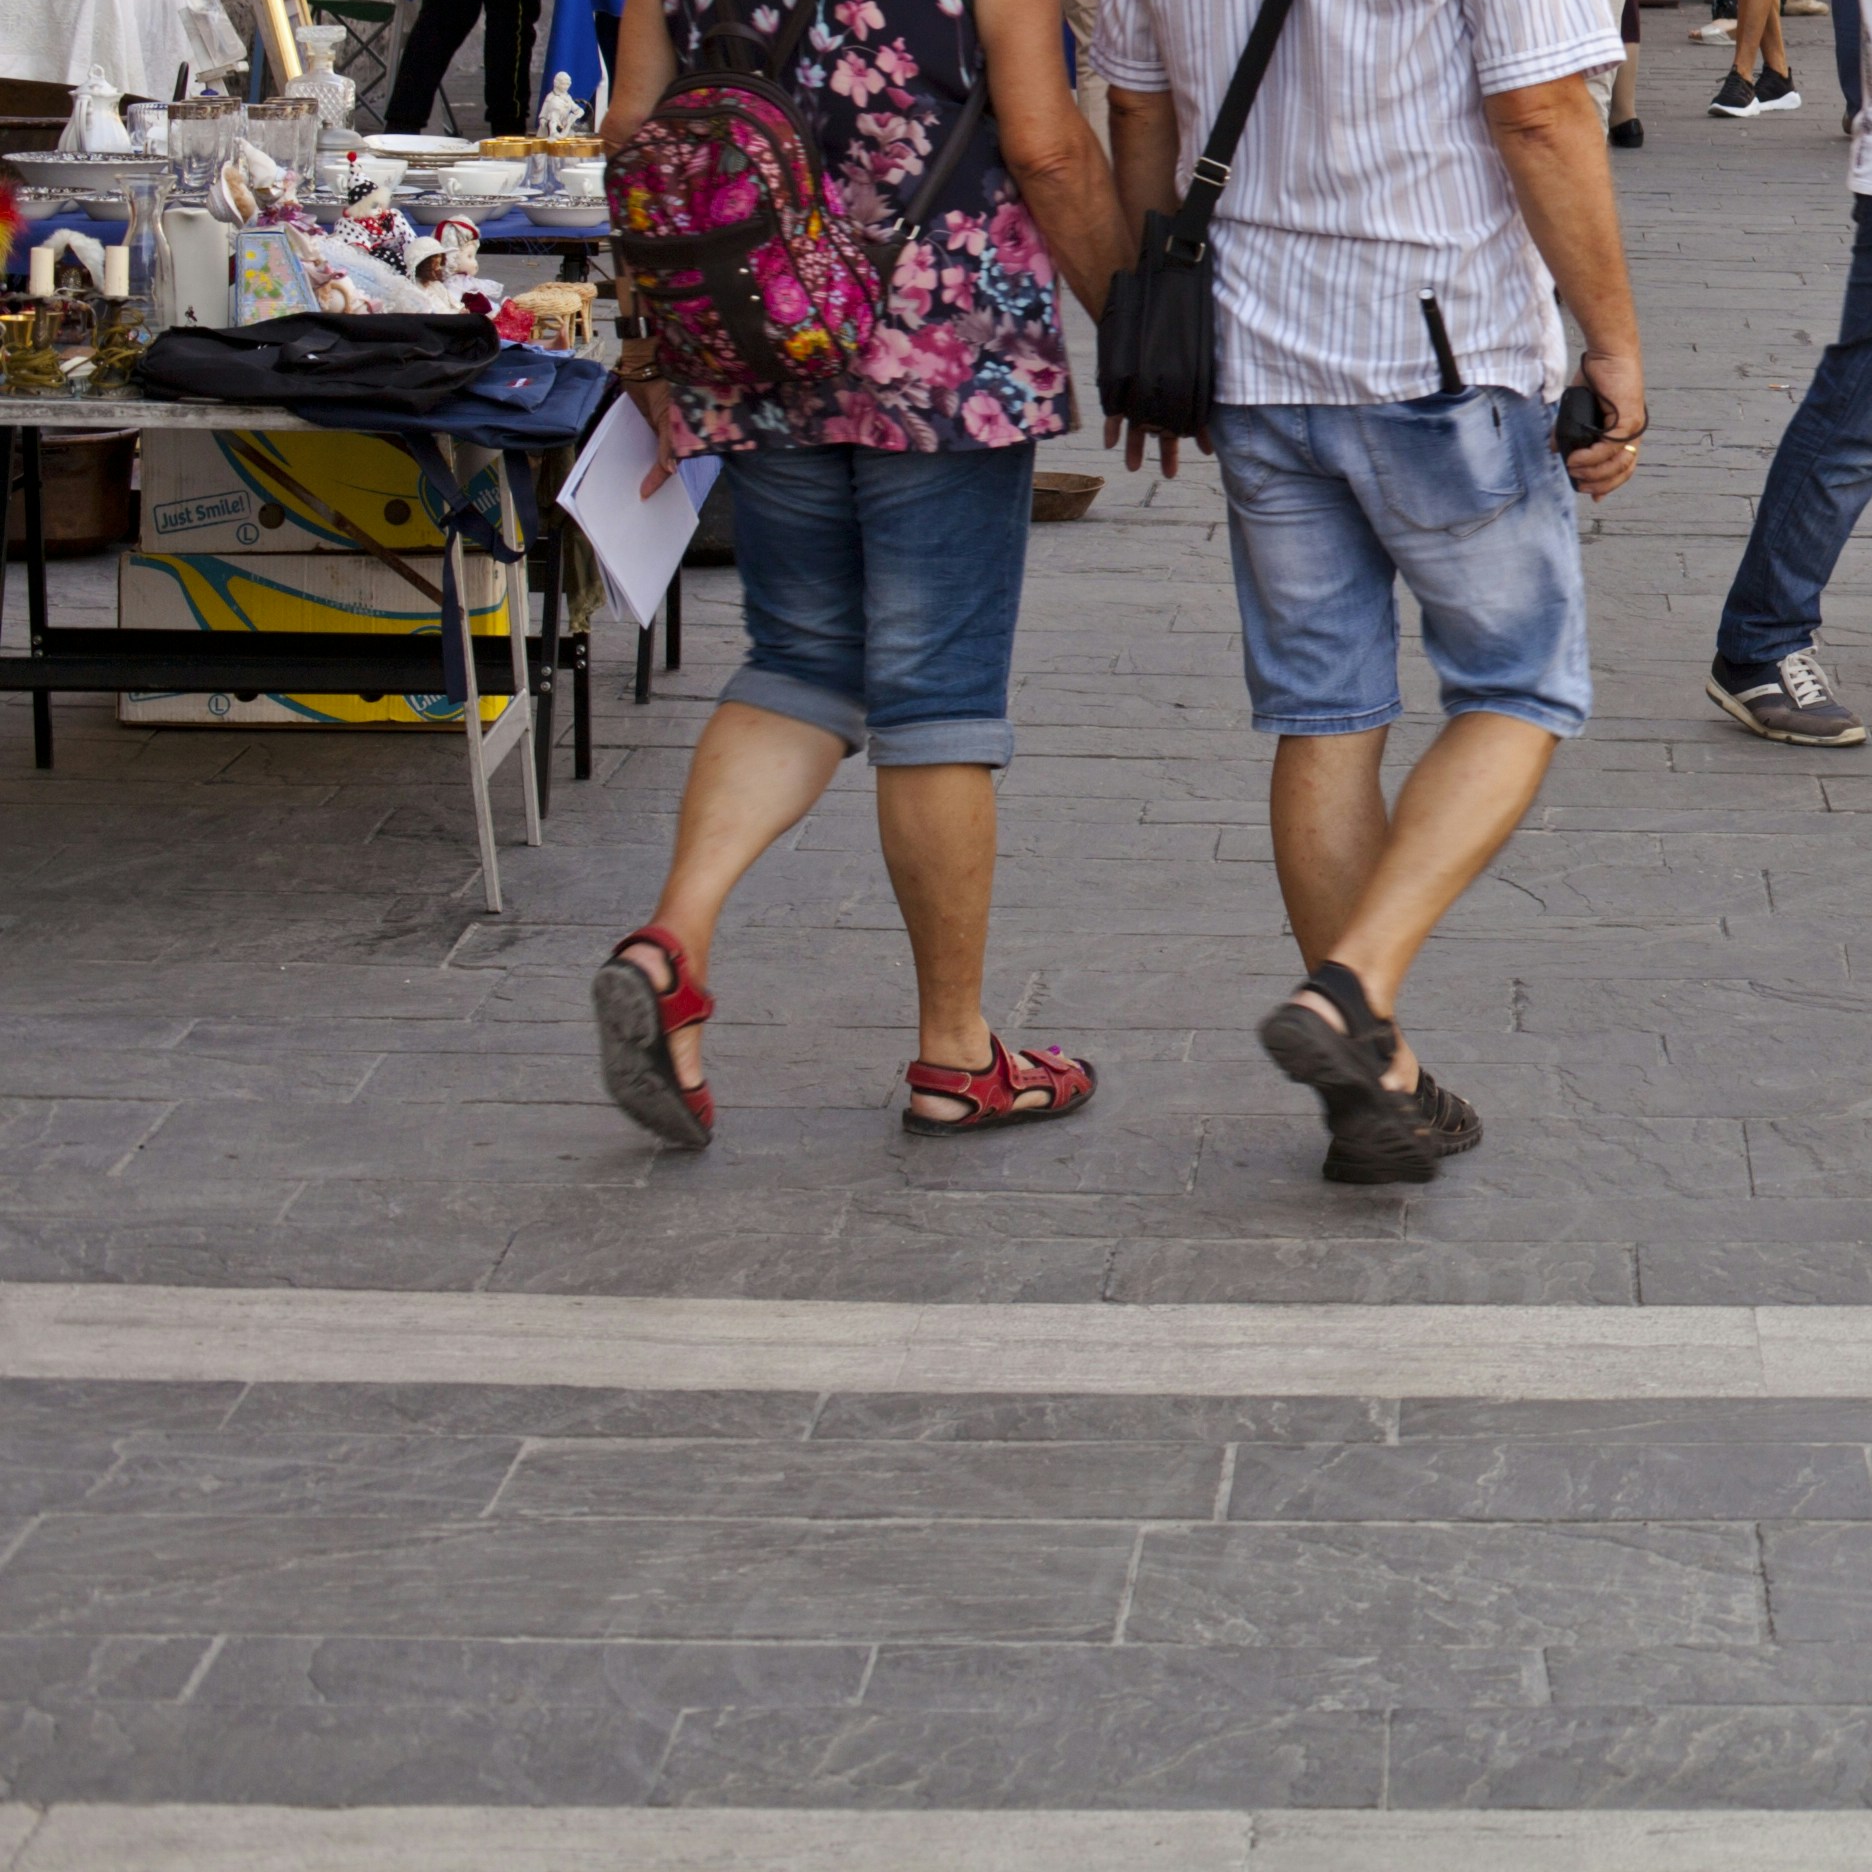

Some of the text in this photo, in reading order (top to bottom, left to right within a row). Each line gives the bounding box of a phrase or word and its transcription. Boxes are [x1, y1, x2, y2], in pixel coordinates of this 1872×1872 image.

[161, 495, 245, 529] Just Smile!
[243, 526, 253, 541] L
[214, 697, 225, 712] L
